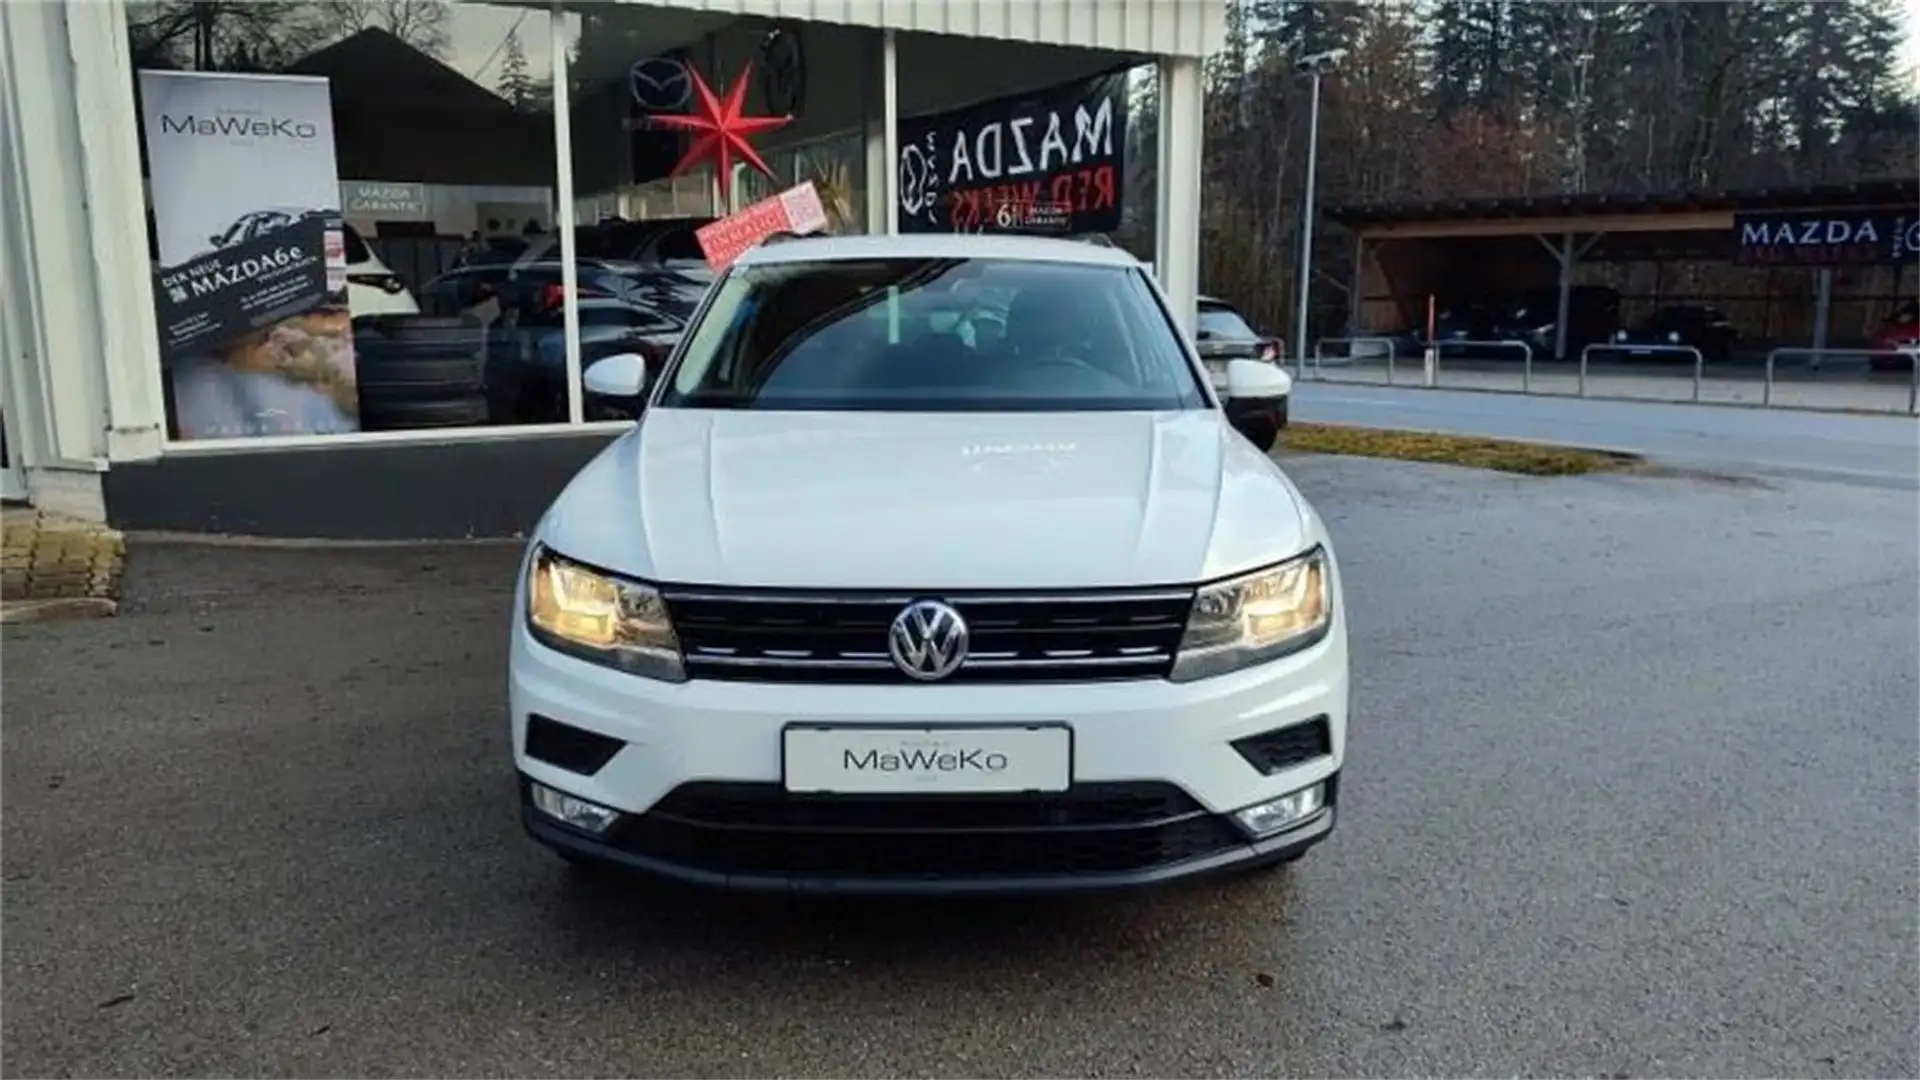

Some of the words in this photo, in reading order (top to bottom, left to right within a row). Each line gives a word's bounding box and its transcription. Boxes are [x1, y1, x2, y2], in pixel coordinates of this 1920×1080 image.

[161, 114, 316, 138] MaWeKo
[1741, 220, 1878, 245] MAZDA
[191, 245, 303, 297] MAZDA6e
[843, 749, 1008, 771] MaWeKo
